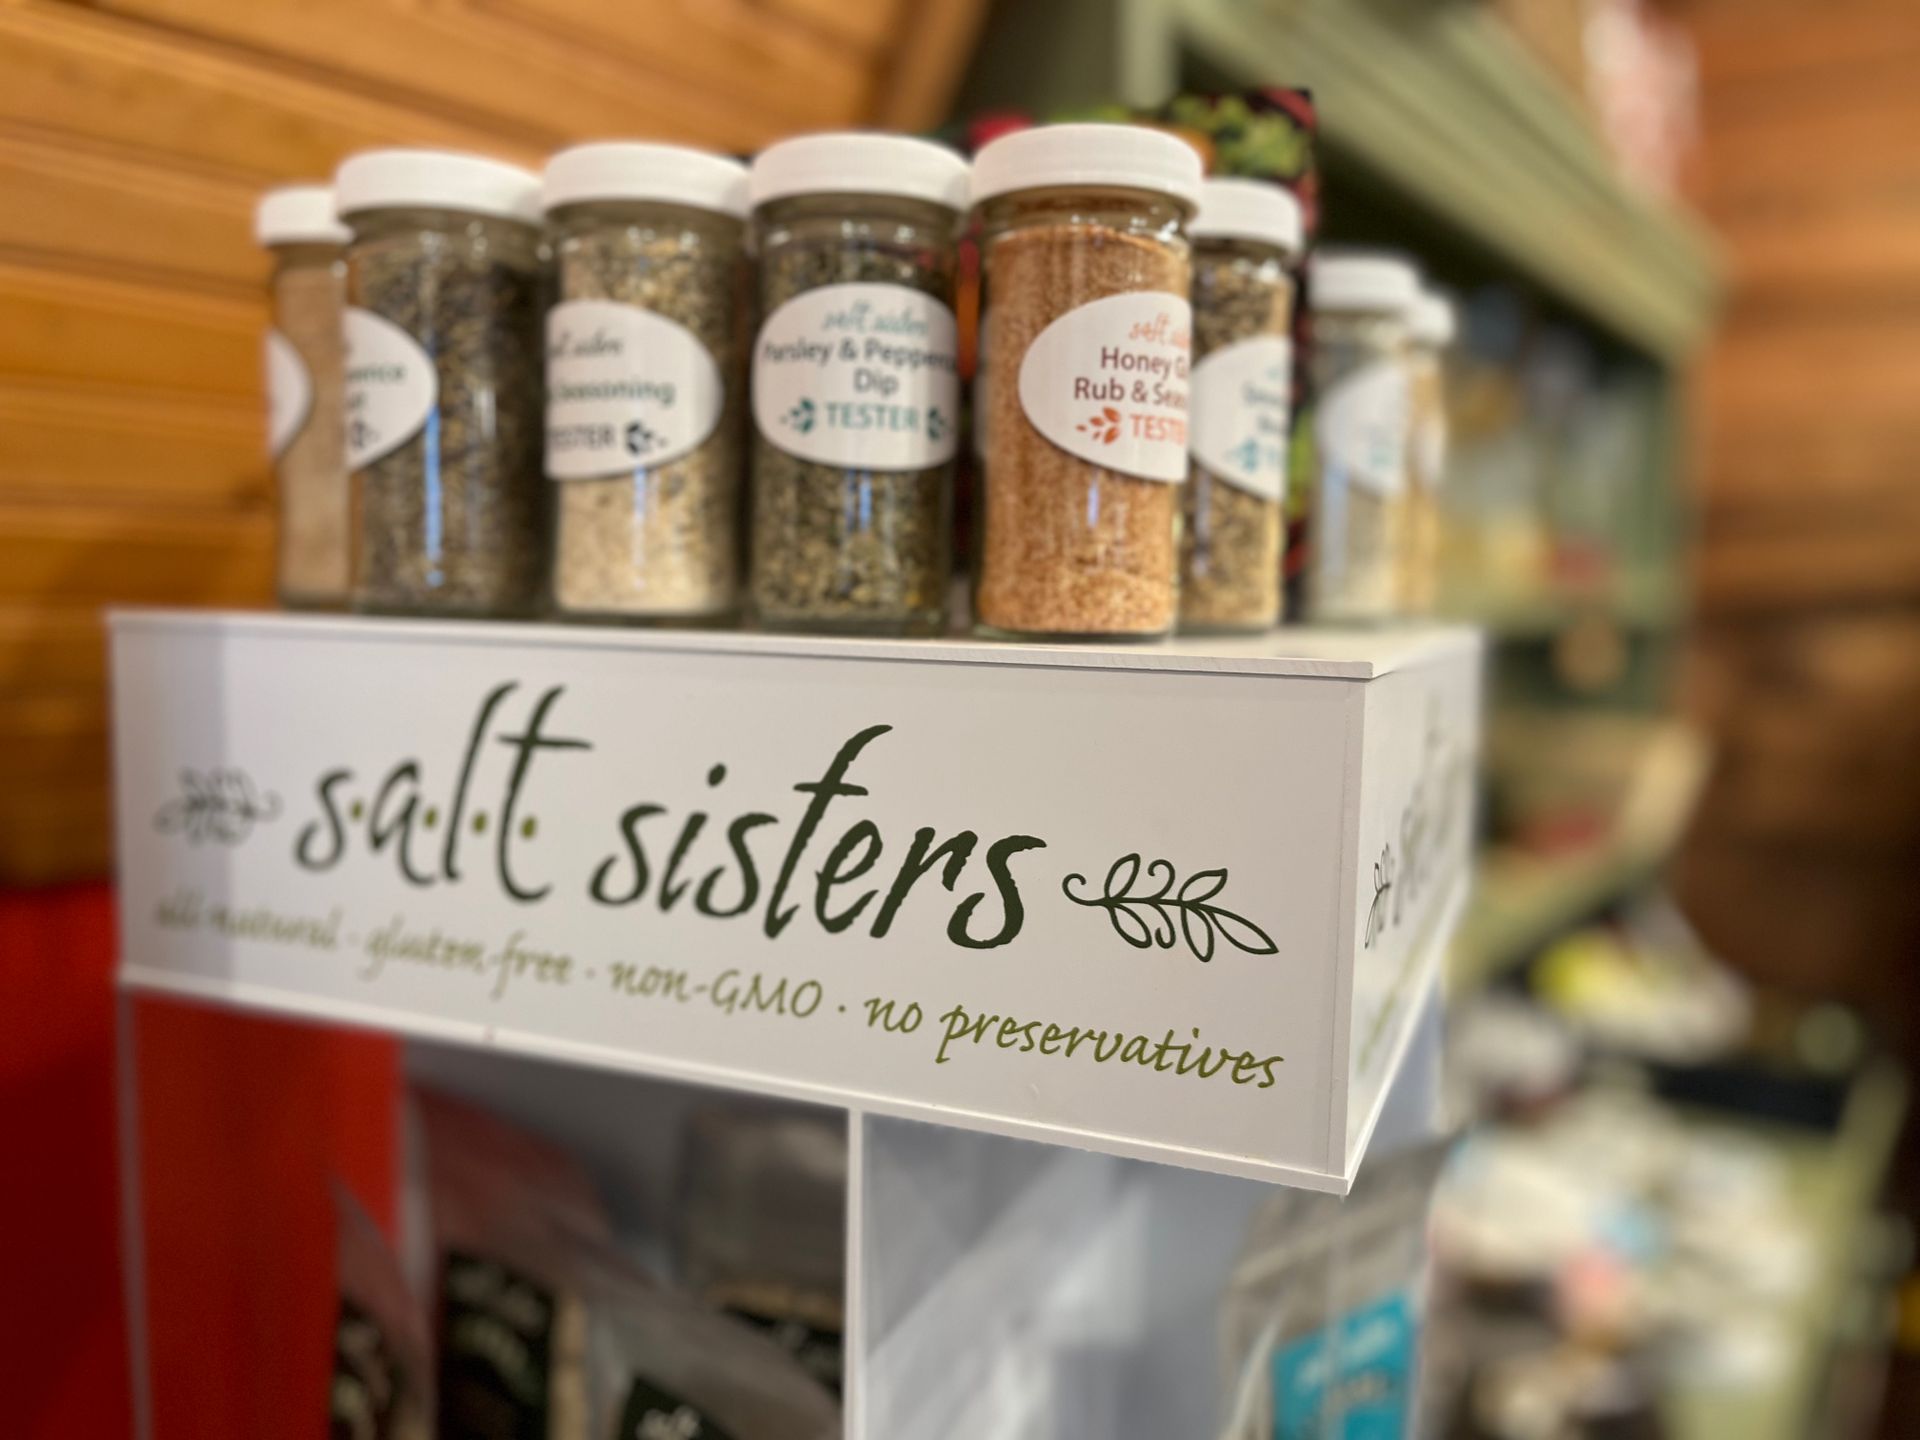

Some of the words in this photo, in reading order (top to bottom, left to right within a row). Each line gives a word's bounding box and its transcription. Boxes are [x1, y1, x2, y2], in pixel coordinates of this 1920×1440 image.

[838, 336, 858, 361] &
[1101, 346, 1171, 381] Honey
[853, 368, 899, 397] Dip
[1073, 377, 1125, 401] Rub
[1130, 380, 1148, 403] &
[826, 402, 918, 432] TESTER
[587, 724, 1047, 949] sisters
[210, 906, 341, 952] natural
[607, 962, 822, 1018] non-GMO
[863, 997, 923, 1034] no
[935, 1004, 1284, 1088] preservatives
